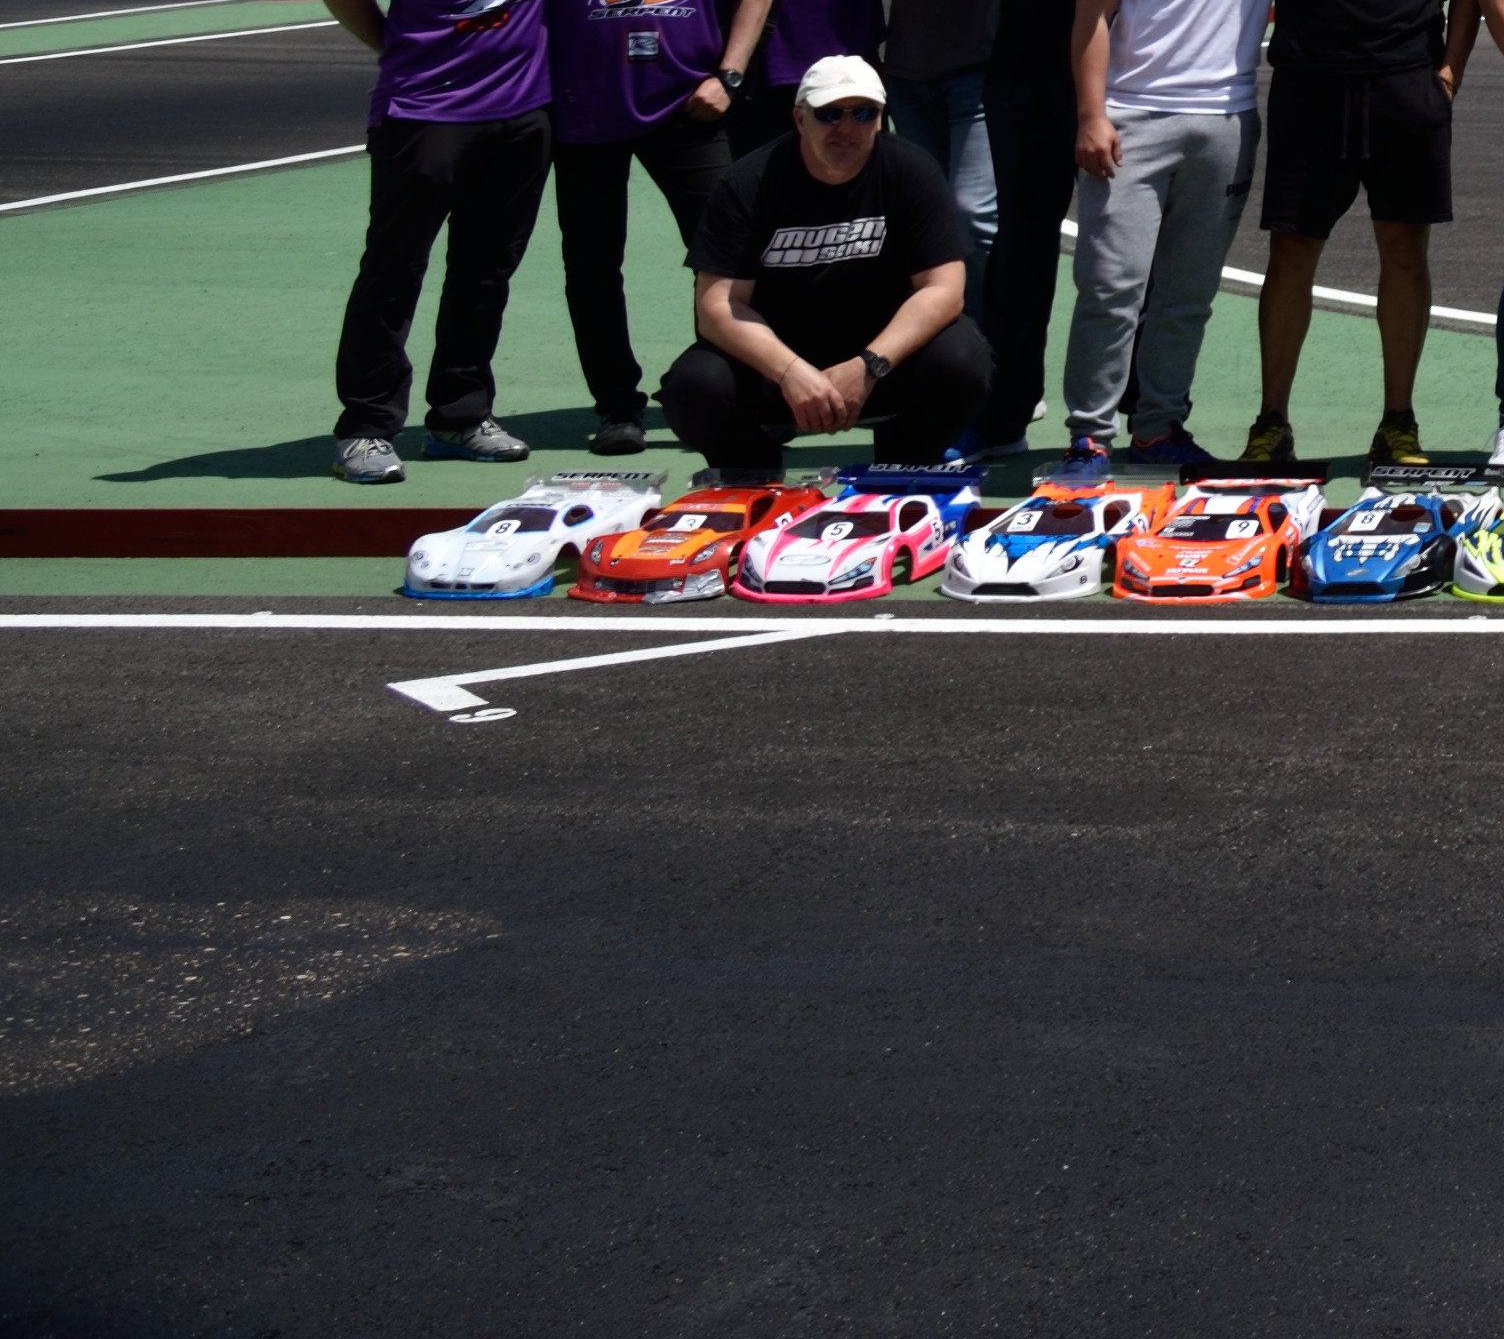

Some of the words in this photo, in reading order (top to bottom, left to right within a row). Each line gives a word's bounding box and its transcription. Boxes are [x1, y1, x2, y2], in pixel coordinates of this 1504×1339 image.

[552, 472, 653, 482] SERPENT
[1372, 466, 1477, 478] SERPENT
[1362, 513, 1375, 524] 8
[496, 519, 509, 534] 8
[829, 522, 844, 537] 5
[1238, 521, 1250, 533] 9
